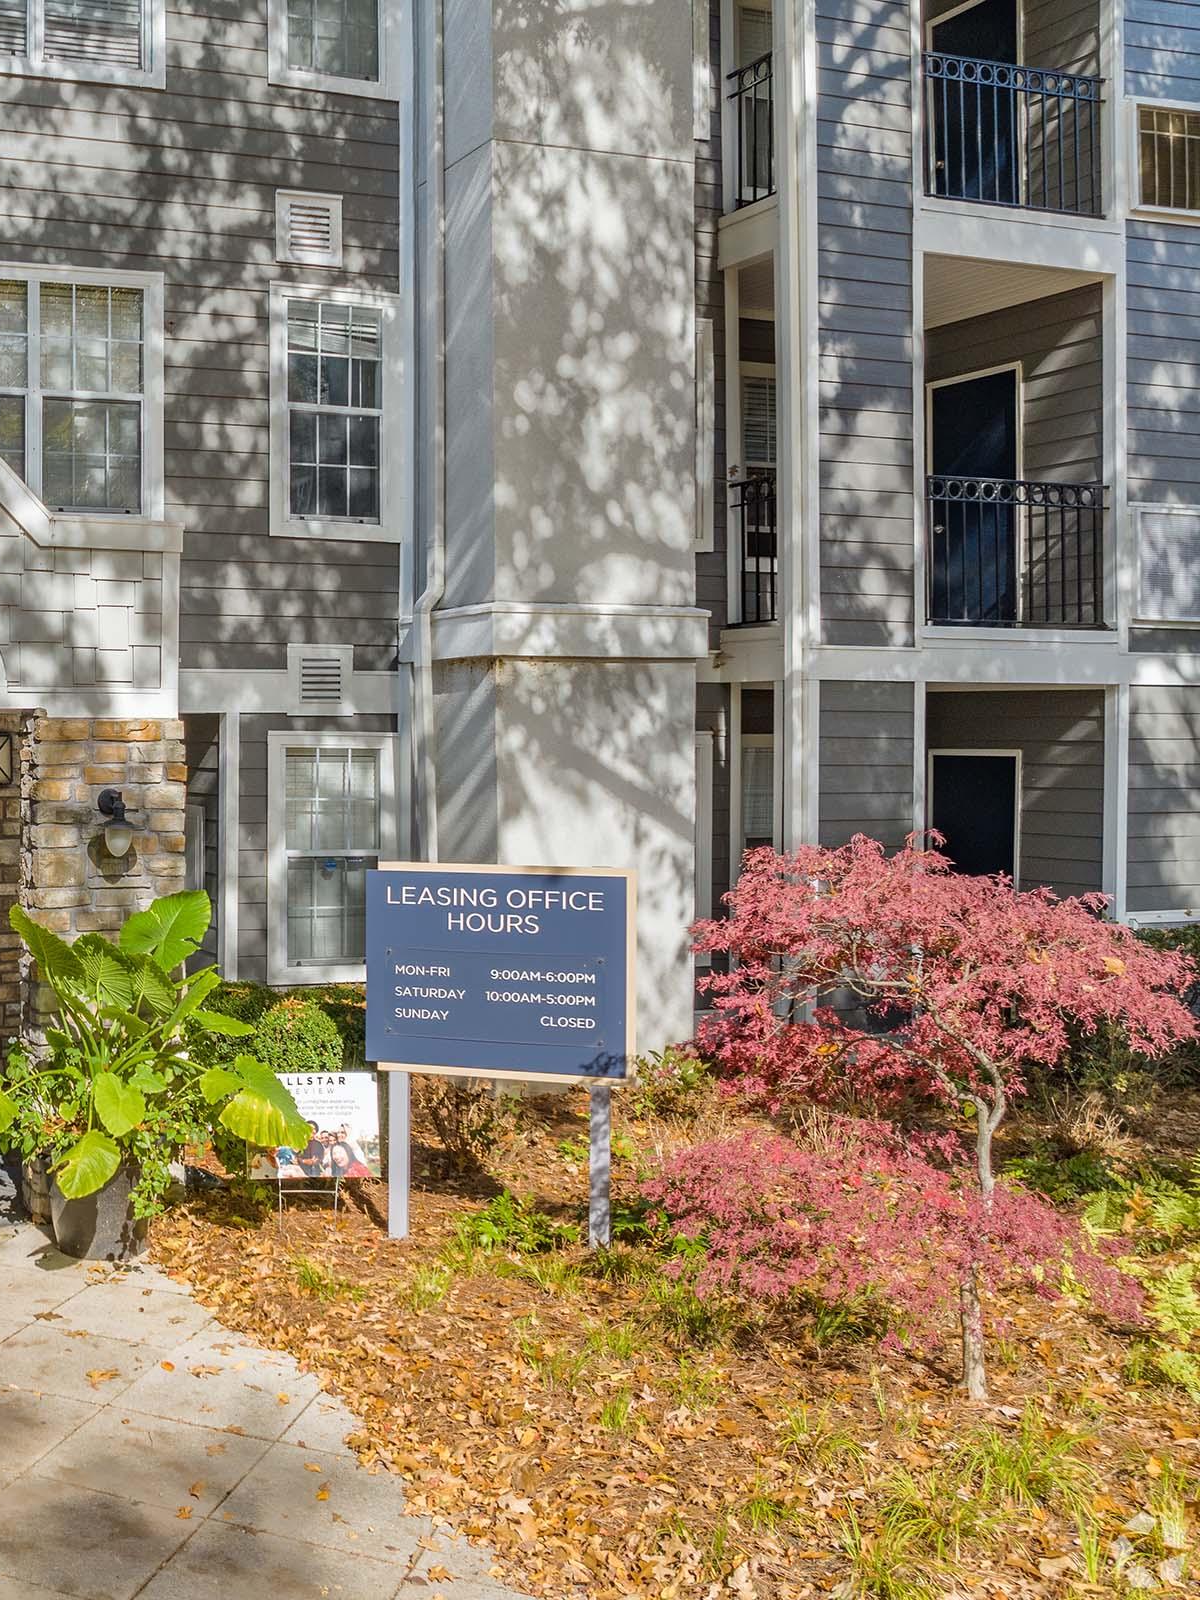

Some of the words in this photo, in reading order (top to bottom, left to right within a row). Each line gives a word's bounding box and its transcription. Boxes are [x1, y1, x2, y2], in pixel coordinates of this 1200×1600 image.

[387, 886, 497, 907] LEASING
[506, 889, 604, 911] OFFICE
[447, 912, 540, 934] HOURS
[395, 964, 450, 977] MON-FRI
[490, 969, 596, 984] 9:00AM-6:00PM
[395, 986, 466, 1000] SATURDAY
[485, 991, 596, 1007] 10:00AM-5:00PM
[395, 1007, 449, 1020] SUNDAY
[540, 1015, 596, 1029] CLOSED
[282, 1076, 346, 1086] LLSTAR
